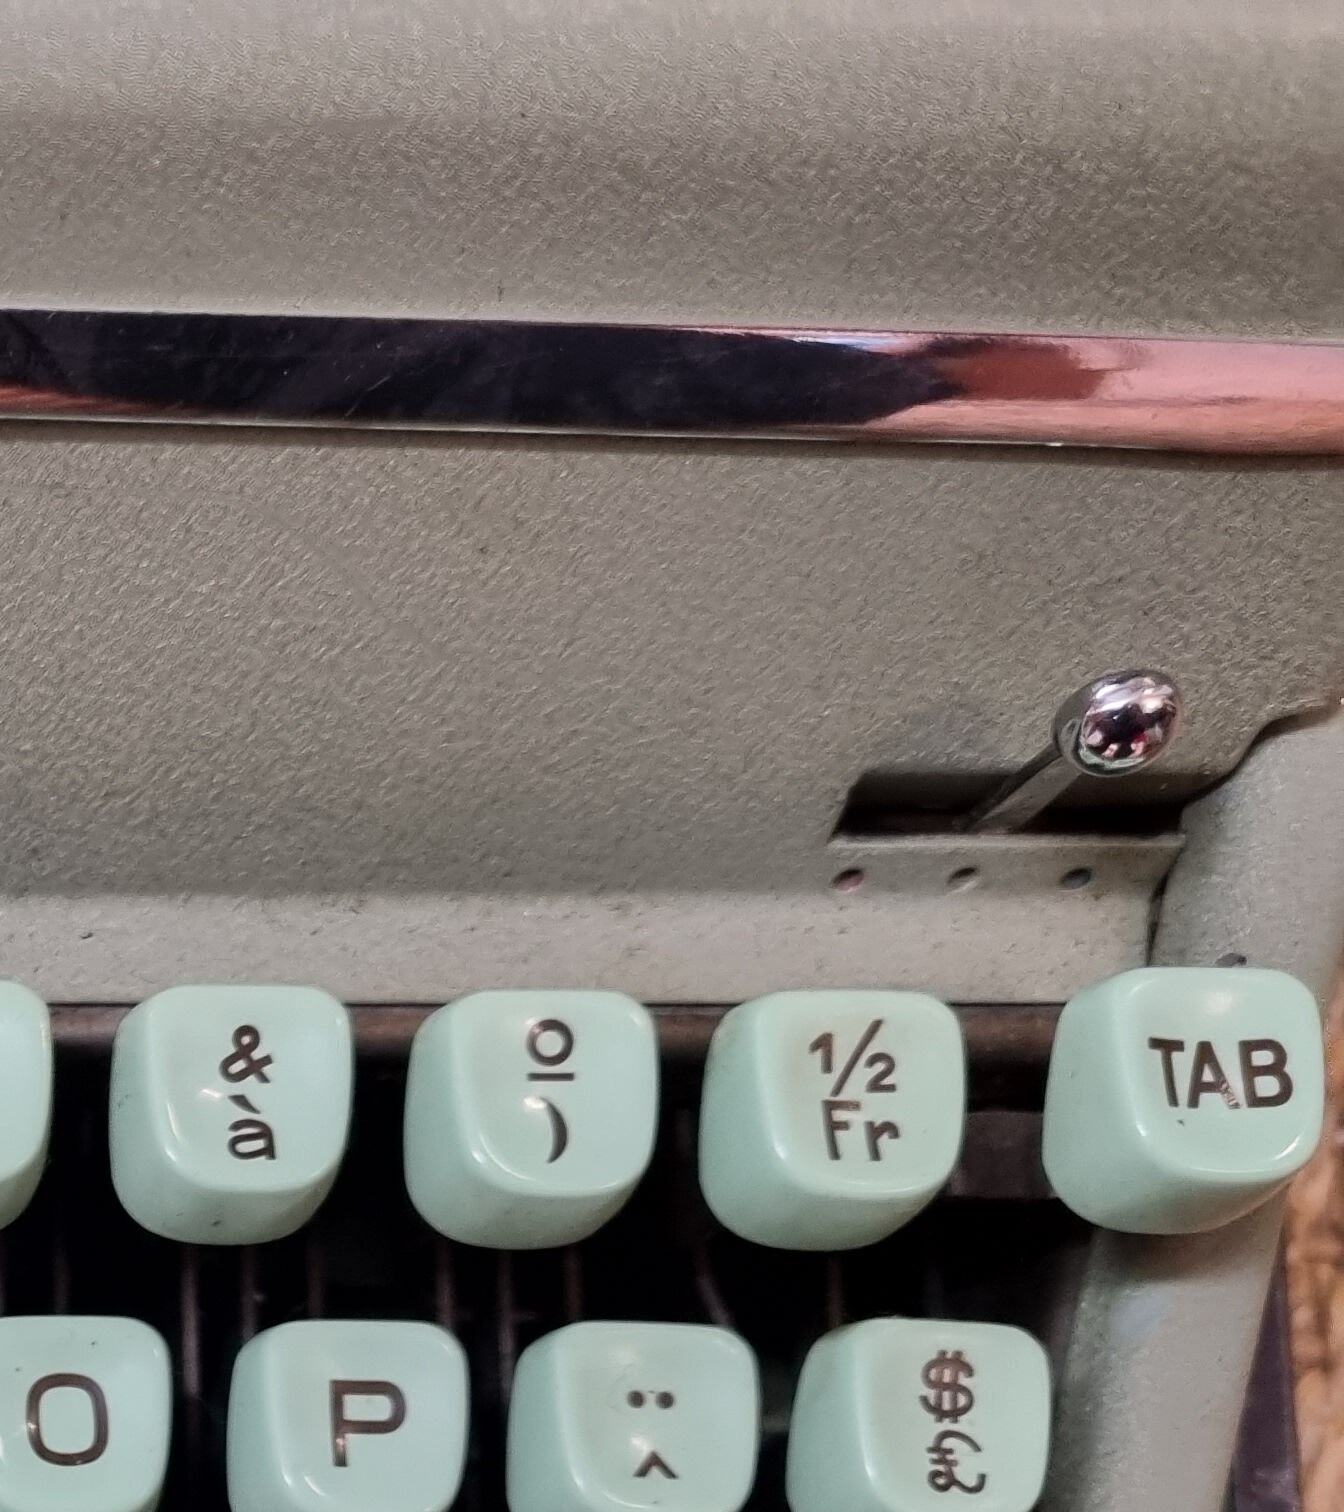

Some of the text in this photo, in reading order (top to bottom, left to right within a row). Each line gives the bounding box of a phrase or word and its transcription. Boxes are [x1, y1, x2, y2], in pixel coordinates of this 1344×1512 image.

[219, 1023, 273, 1087] &
[1148, 1036, 1294, 1109] TAB
[225, 1093, 277, 1162] à
[821, 1099, 901, 1162] Fr
[26, 1372, 109, 1467] O
[329, 1379, 407, 1468] P
[917, 1349, 976, 1425] $
